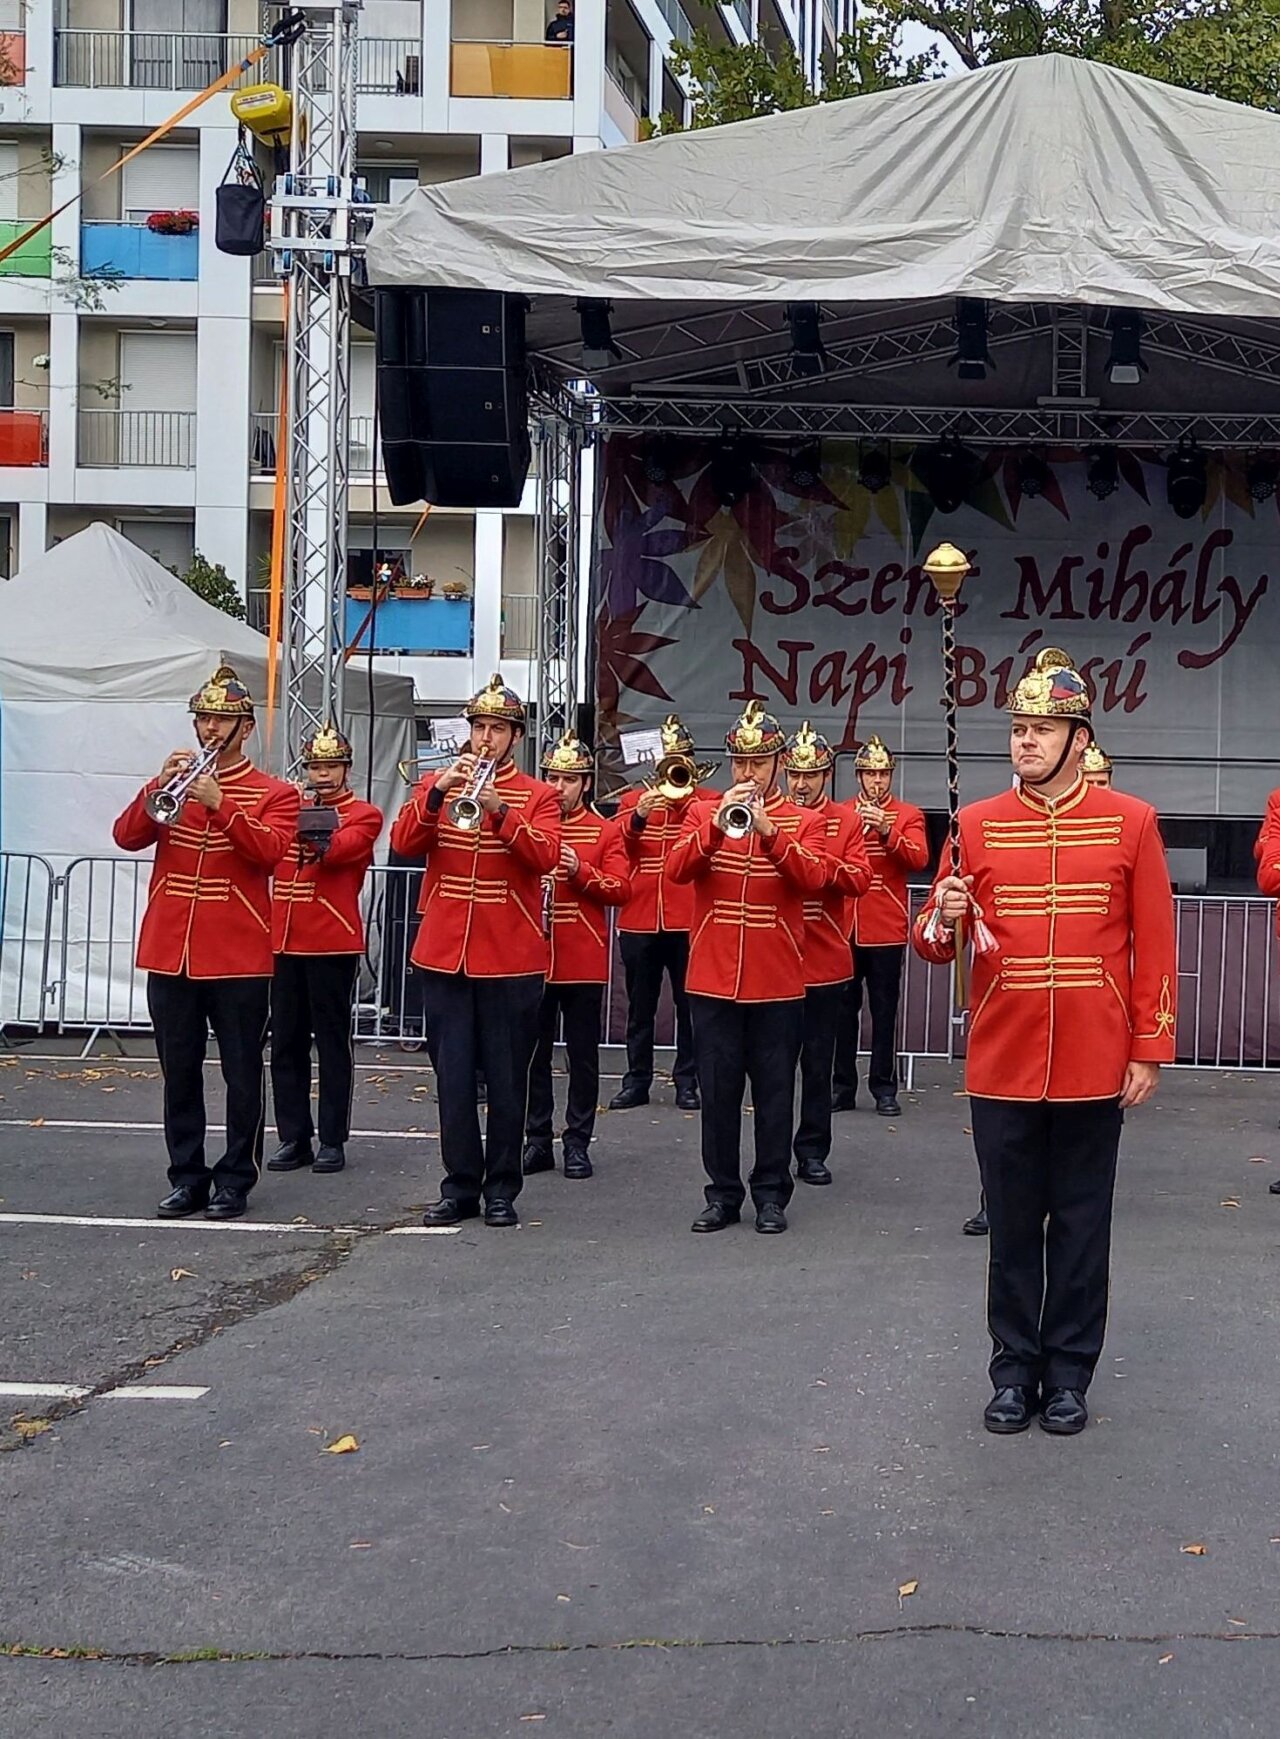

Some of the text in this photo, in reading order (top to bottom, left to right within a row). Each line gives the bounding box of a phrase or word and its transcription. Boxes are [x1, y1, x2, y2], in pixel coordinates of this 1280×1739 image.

[1000, 525, 1268, 669] Mihály
[729, 627, 1151, 749] Napi Búsú
